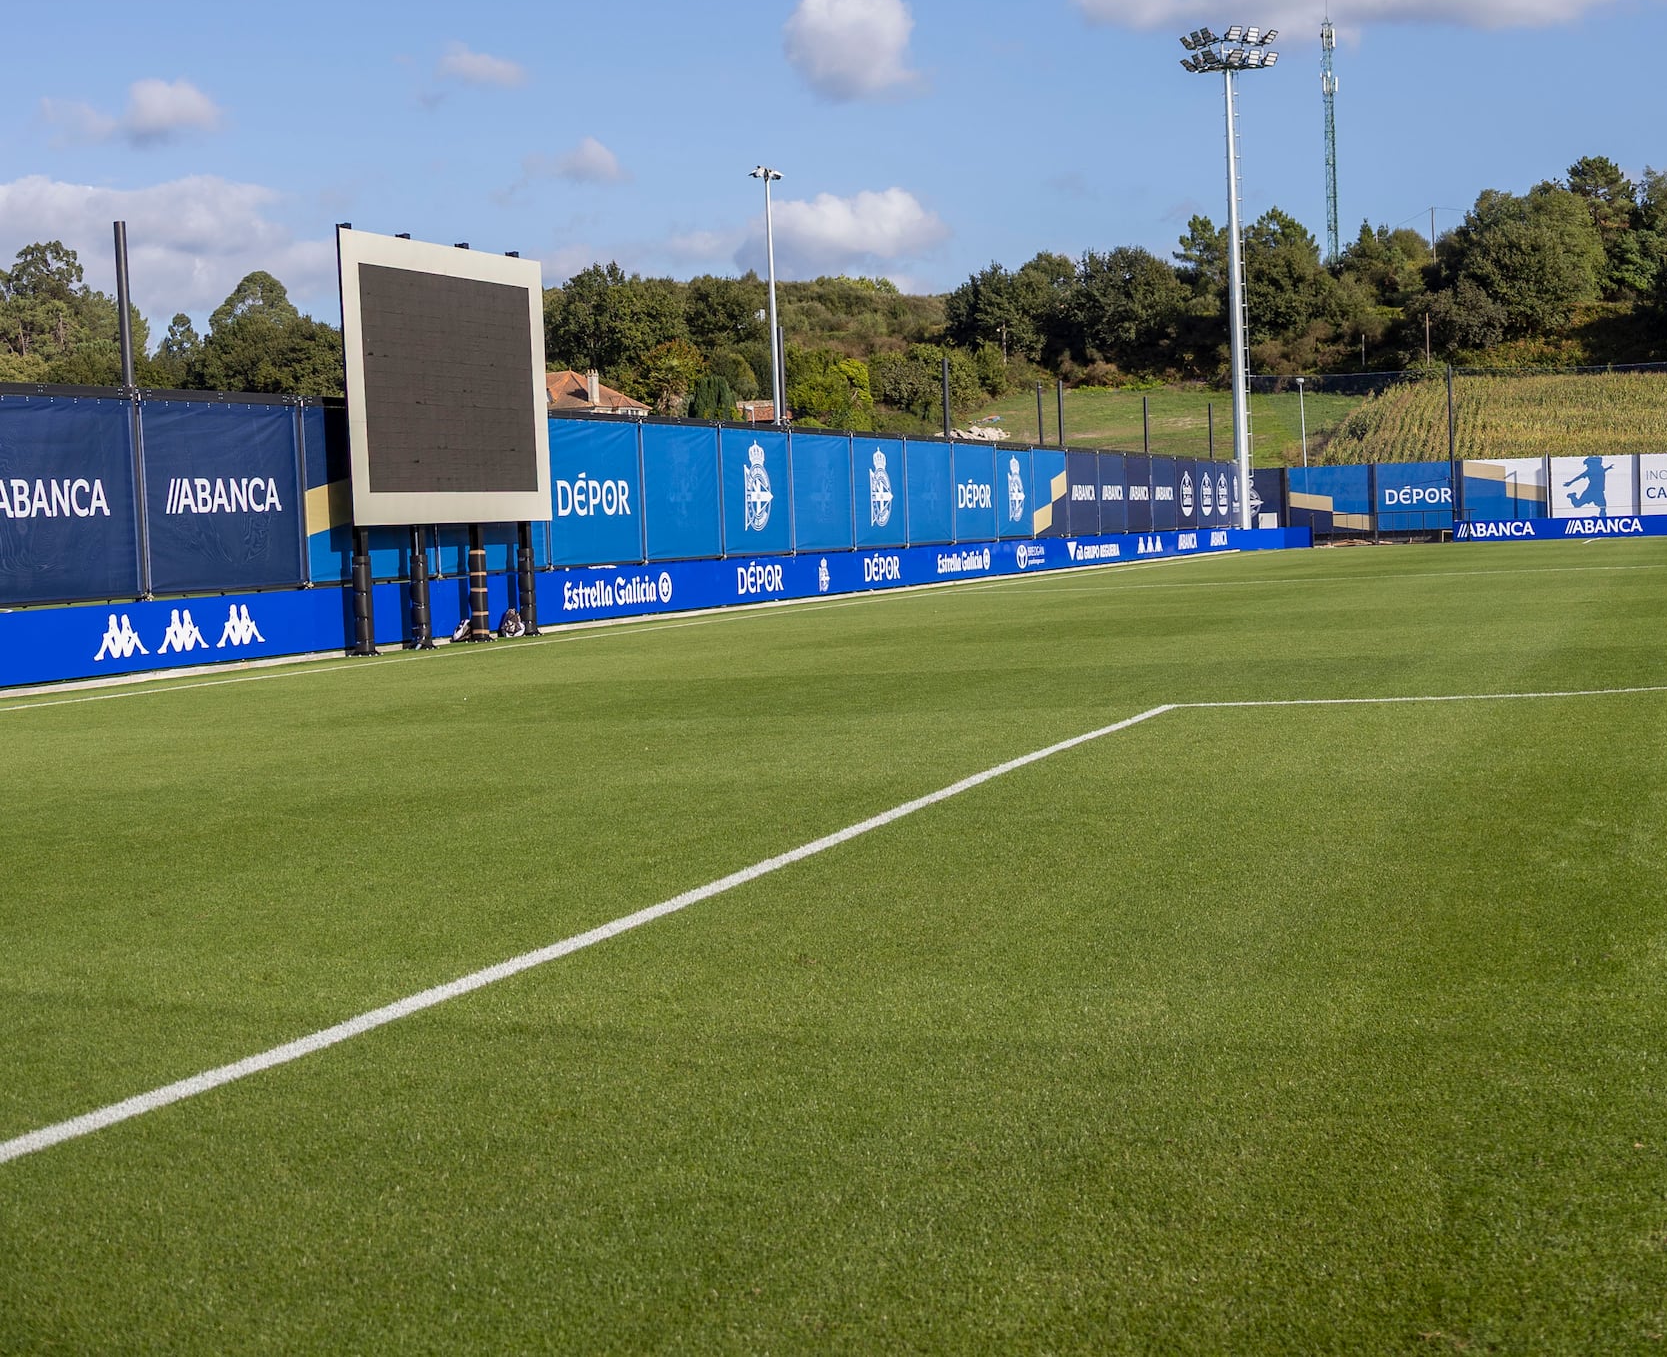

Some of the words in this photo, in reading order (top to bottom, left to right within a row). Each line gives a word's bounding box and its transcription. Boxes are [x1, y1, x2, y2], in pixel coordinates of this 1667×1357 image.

[0, 478, 110, 518] ABANCA
[556, 472, 631, 516] DÉPOR
[958, 479, 992, 508] DÉPOR
[1385, 485, 1452, 505] DÉPOR
[737, 561, 784, 595] DÉPOR
[864, 553, 901, 582] DÉPOR
[937, 553, 961, 574] Estrella
[962, 551, 983, 571] Galicia
[563, 580, 613, 610] Estrella
[614, 576, 657, 605] Galicia
